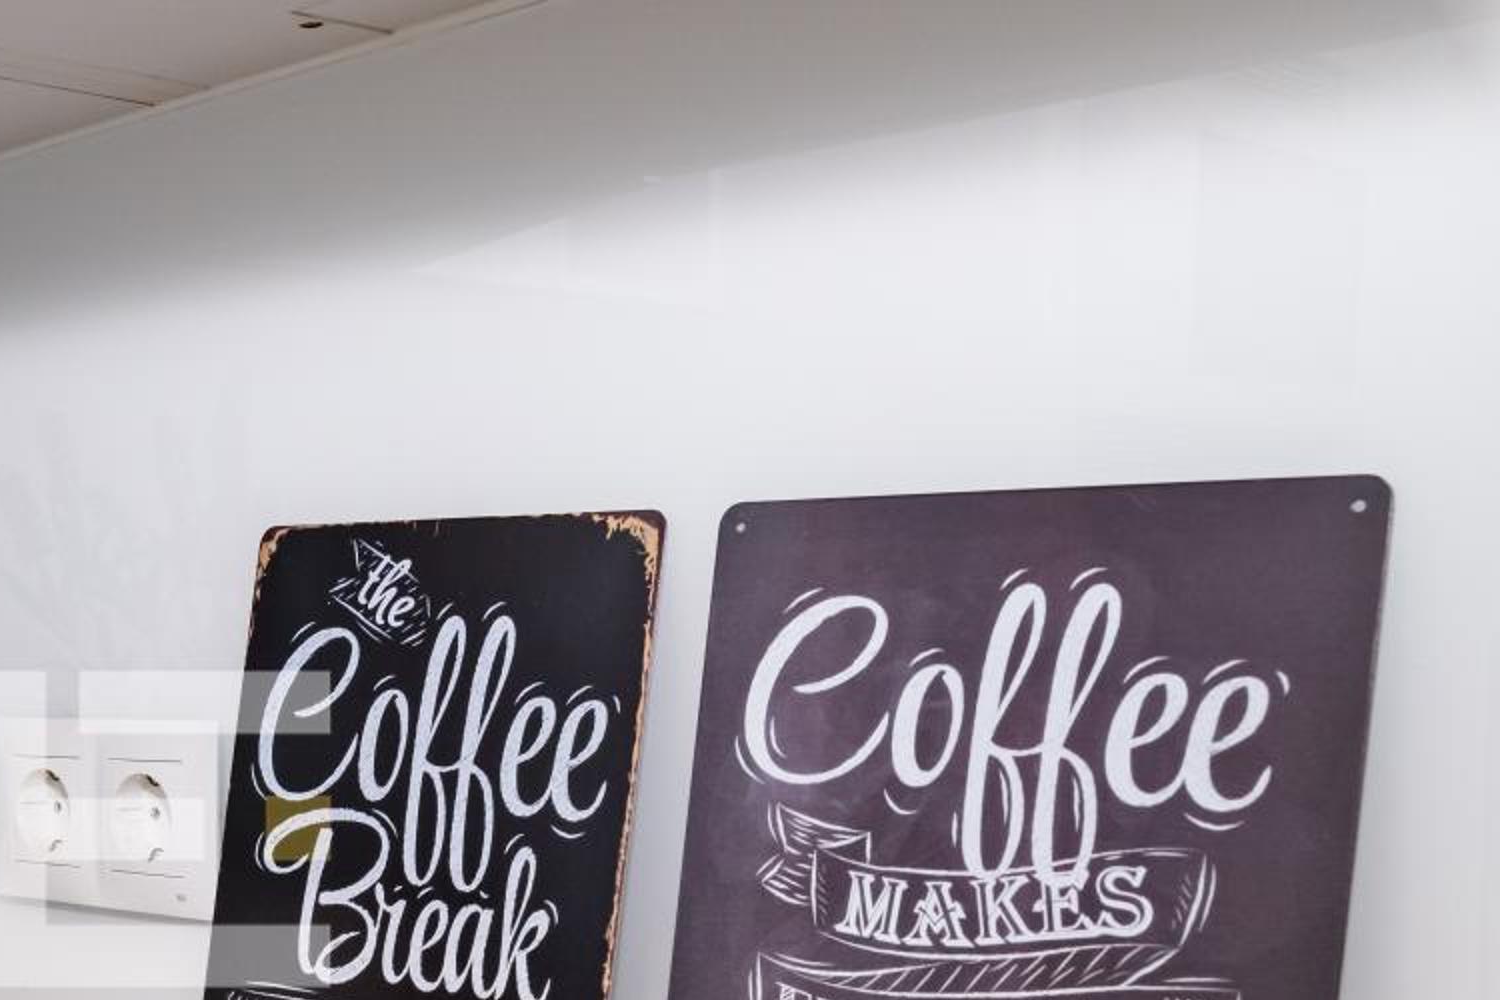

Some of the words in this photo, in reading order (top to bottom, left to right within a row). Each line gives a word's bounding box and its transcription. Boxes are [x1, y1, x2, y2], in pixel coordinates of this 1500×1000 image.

[357, 553, 414, 628] the
[257, 614, 610, 893] Coffee
[743, 582, 1272, 884] Coffee
[835, 865, 1155, 948] MAKES
